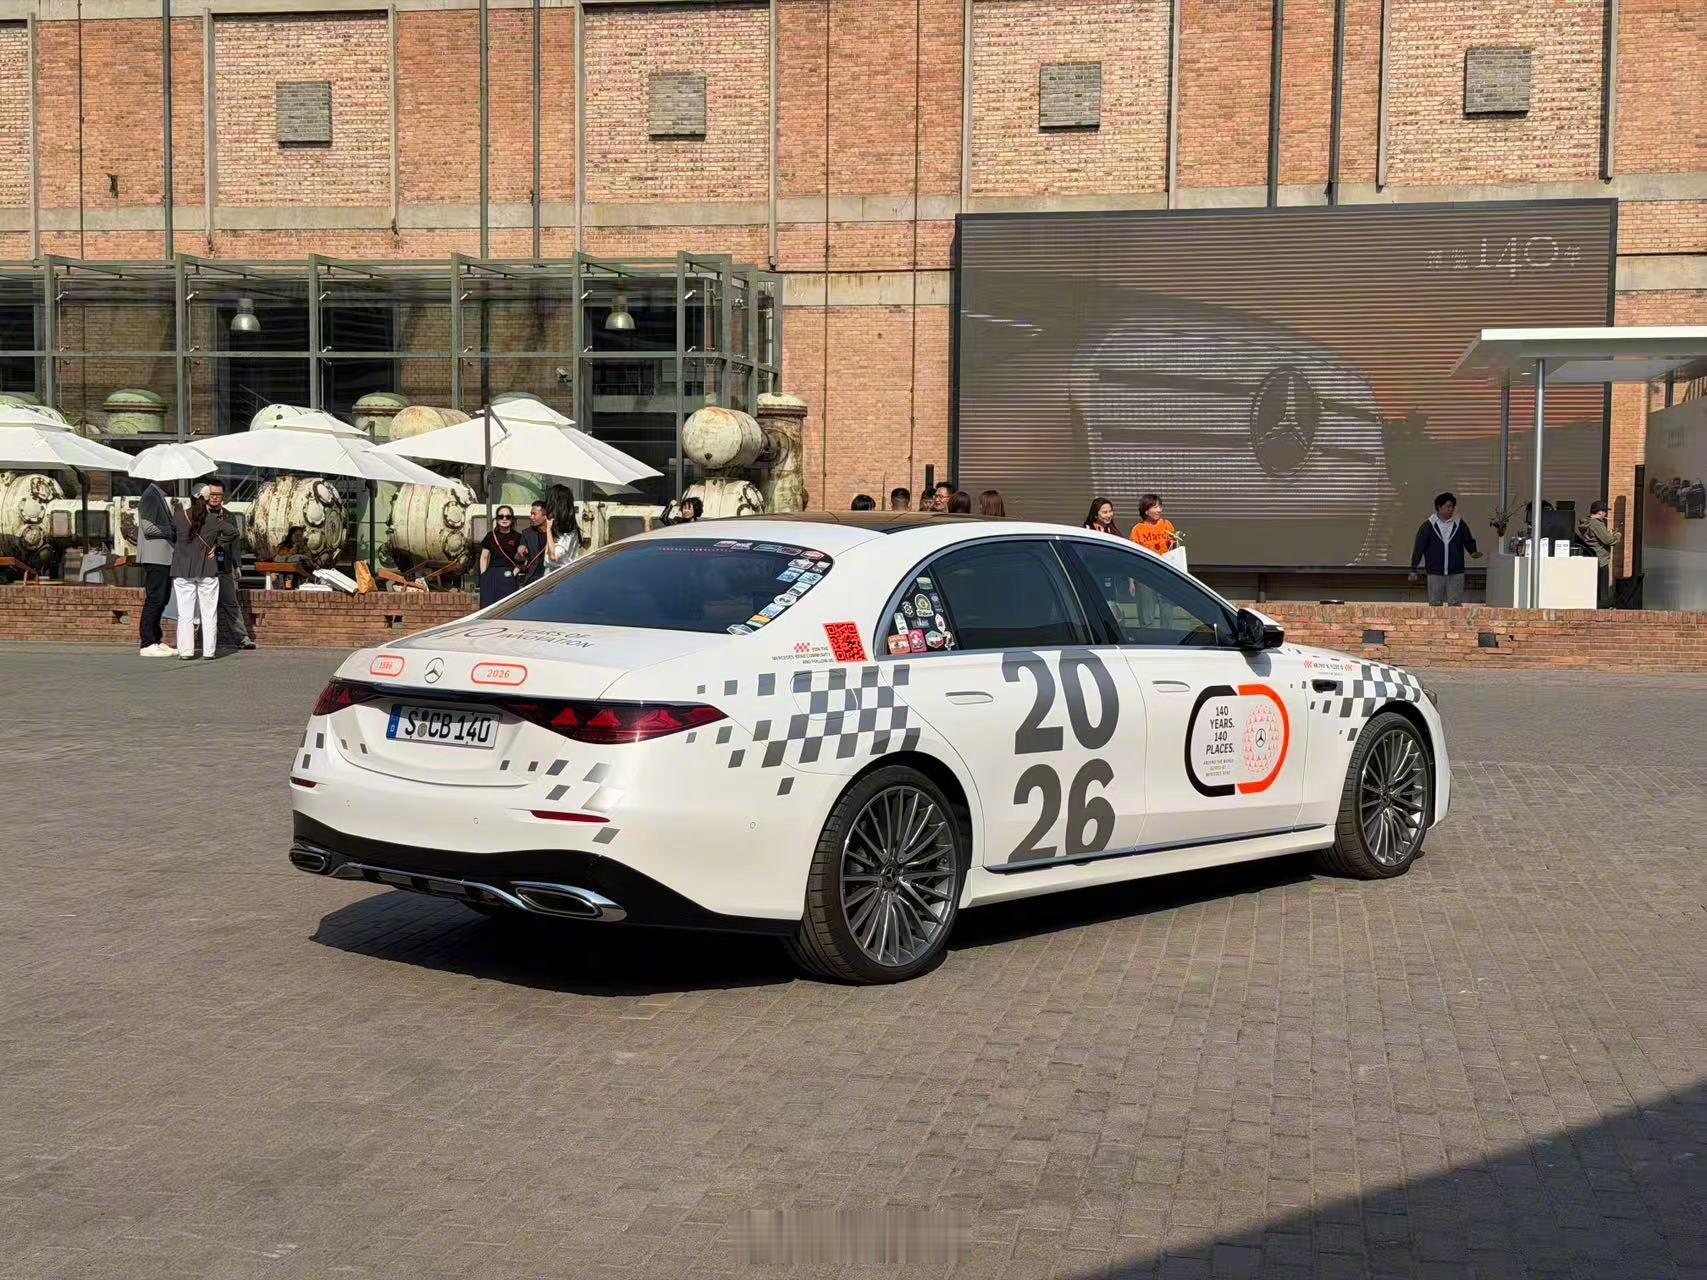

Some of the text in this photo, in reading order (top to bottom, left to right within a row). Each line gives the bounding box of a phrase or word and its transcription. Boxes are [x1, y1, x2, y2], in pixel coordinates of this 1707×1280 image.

[486, 668, 511, 679] 2026
[1001, 650, 1120, 755] 20
[1215, 705, 1229, 717] 140
[404, 710, 492, 743] S CB 140
[1209, 717, 1235, 729] YEARS.
[1214, 730, 1228, 742] 140
[1205, 742, 1235, 755] PLACES.
[1008, 758, 1115, 866] 26
